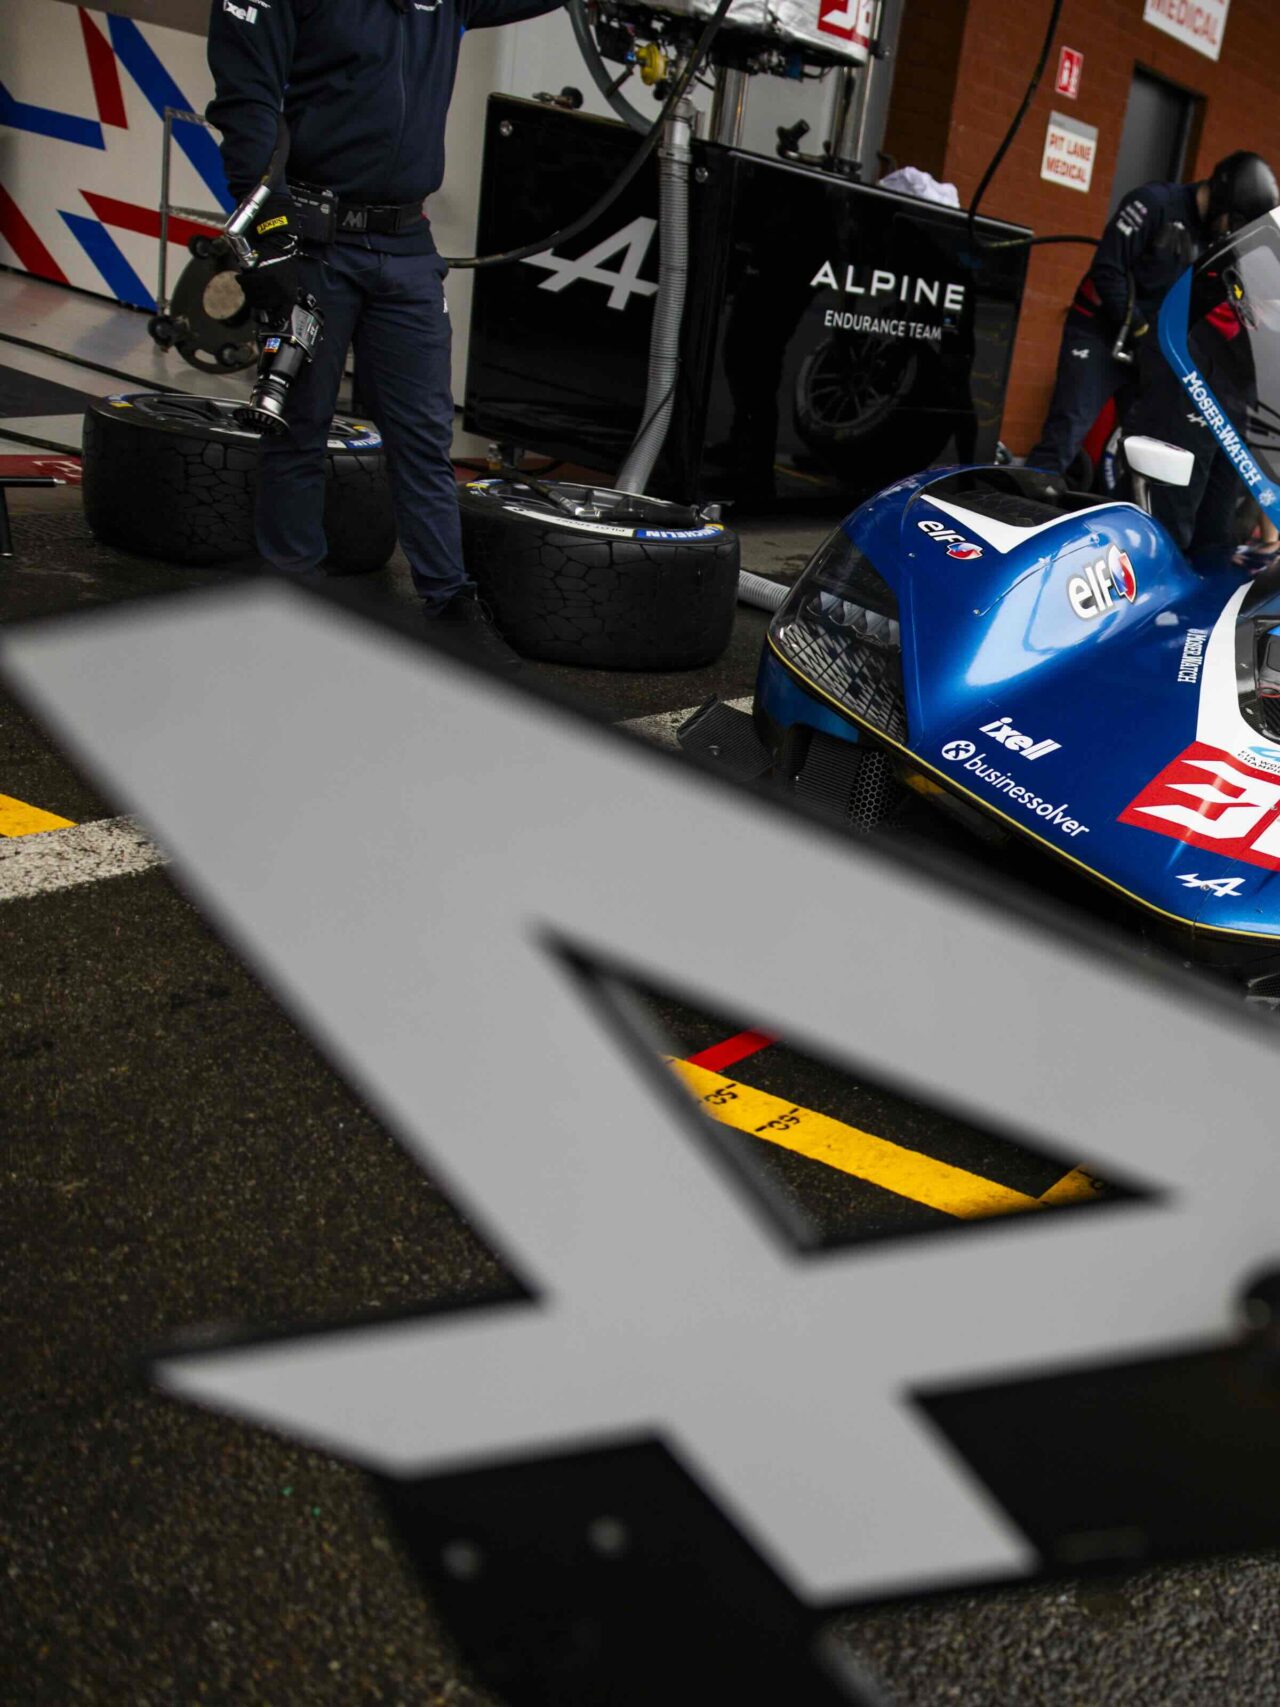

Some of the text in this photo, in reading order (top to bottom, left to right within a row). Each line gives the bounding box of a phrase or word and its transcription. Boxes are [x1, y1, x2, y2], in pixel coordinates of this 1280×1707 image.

[1049, 133, 1091, 161] PIT LANE
[1046, 157, 1086, 183] MEDICAL
[810, 260, 965, 310] ALPINE
[824, 310, 942, 341] ENDURANCE TEAM
[917, 520, 967, 544] elf
[1068, 558, 1114, 620] elf
[978, 717, 1062, 761] ixell
[963, 753, 1090, 837] businessolver
